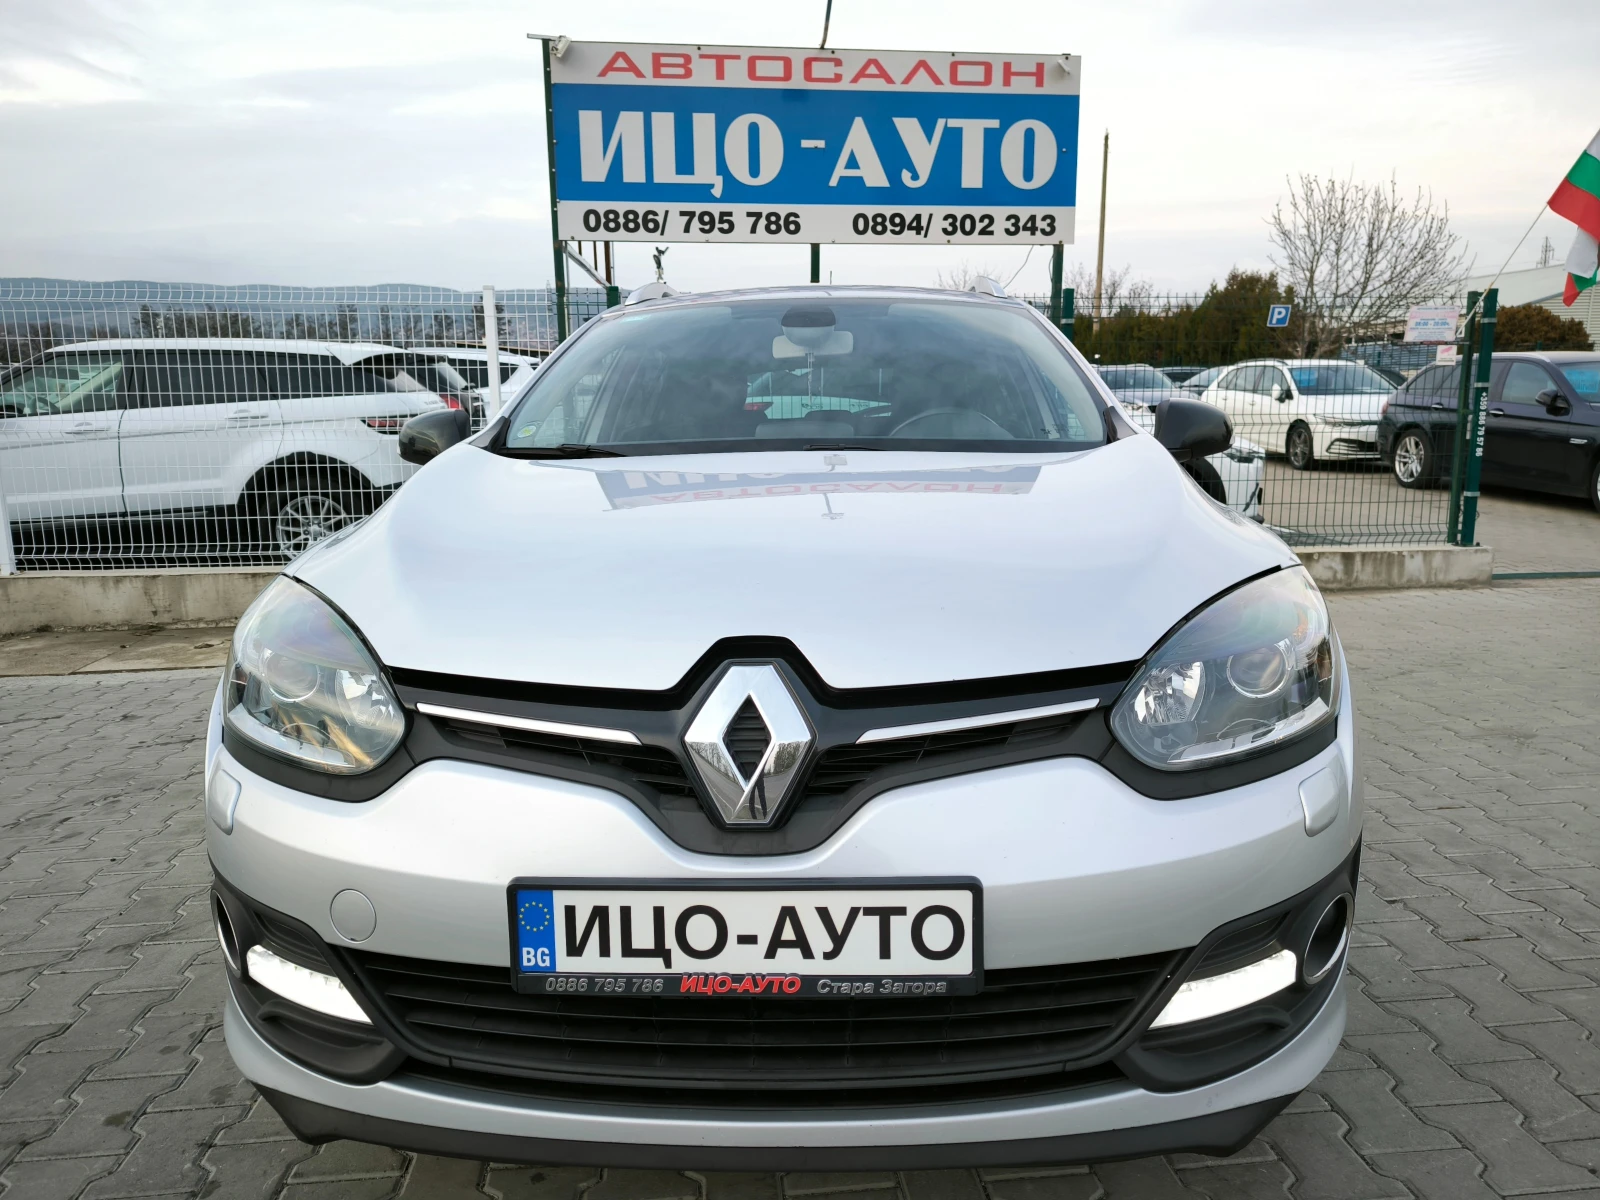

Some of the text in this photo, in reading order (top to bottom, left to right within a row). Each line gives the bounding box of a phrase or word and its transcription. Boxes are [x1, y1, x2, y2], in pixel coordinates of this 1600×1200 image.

[597, 51, 1045, 88] АВТОСАЛОН
[582, 208, 1056, 238] 0886/ 795 786 0894/ 302 343
[1272, 307, 1287, 324] P
[564, 904, 965, 969] ИЦО-АУТО
[522, 947, 550, 968] BG
[545, 975, 947, 996] 0886 795 786 ИЦО-АУТО Стара Загора
